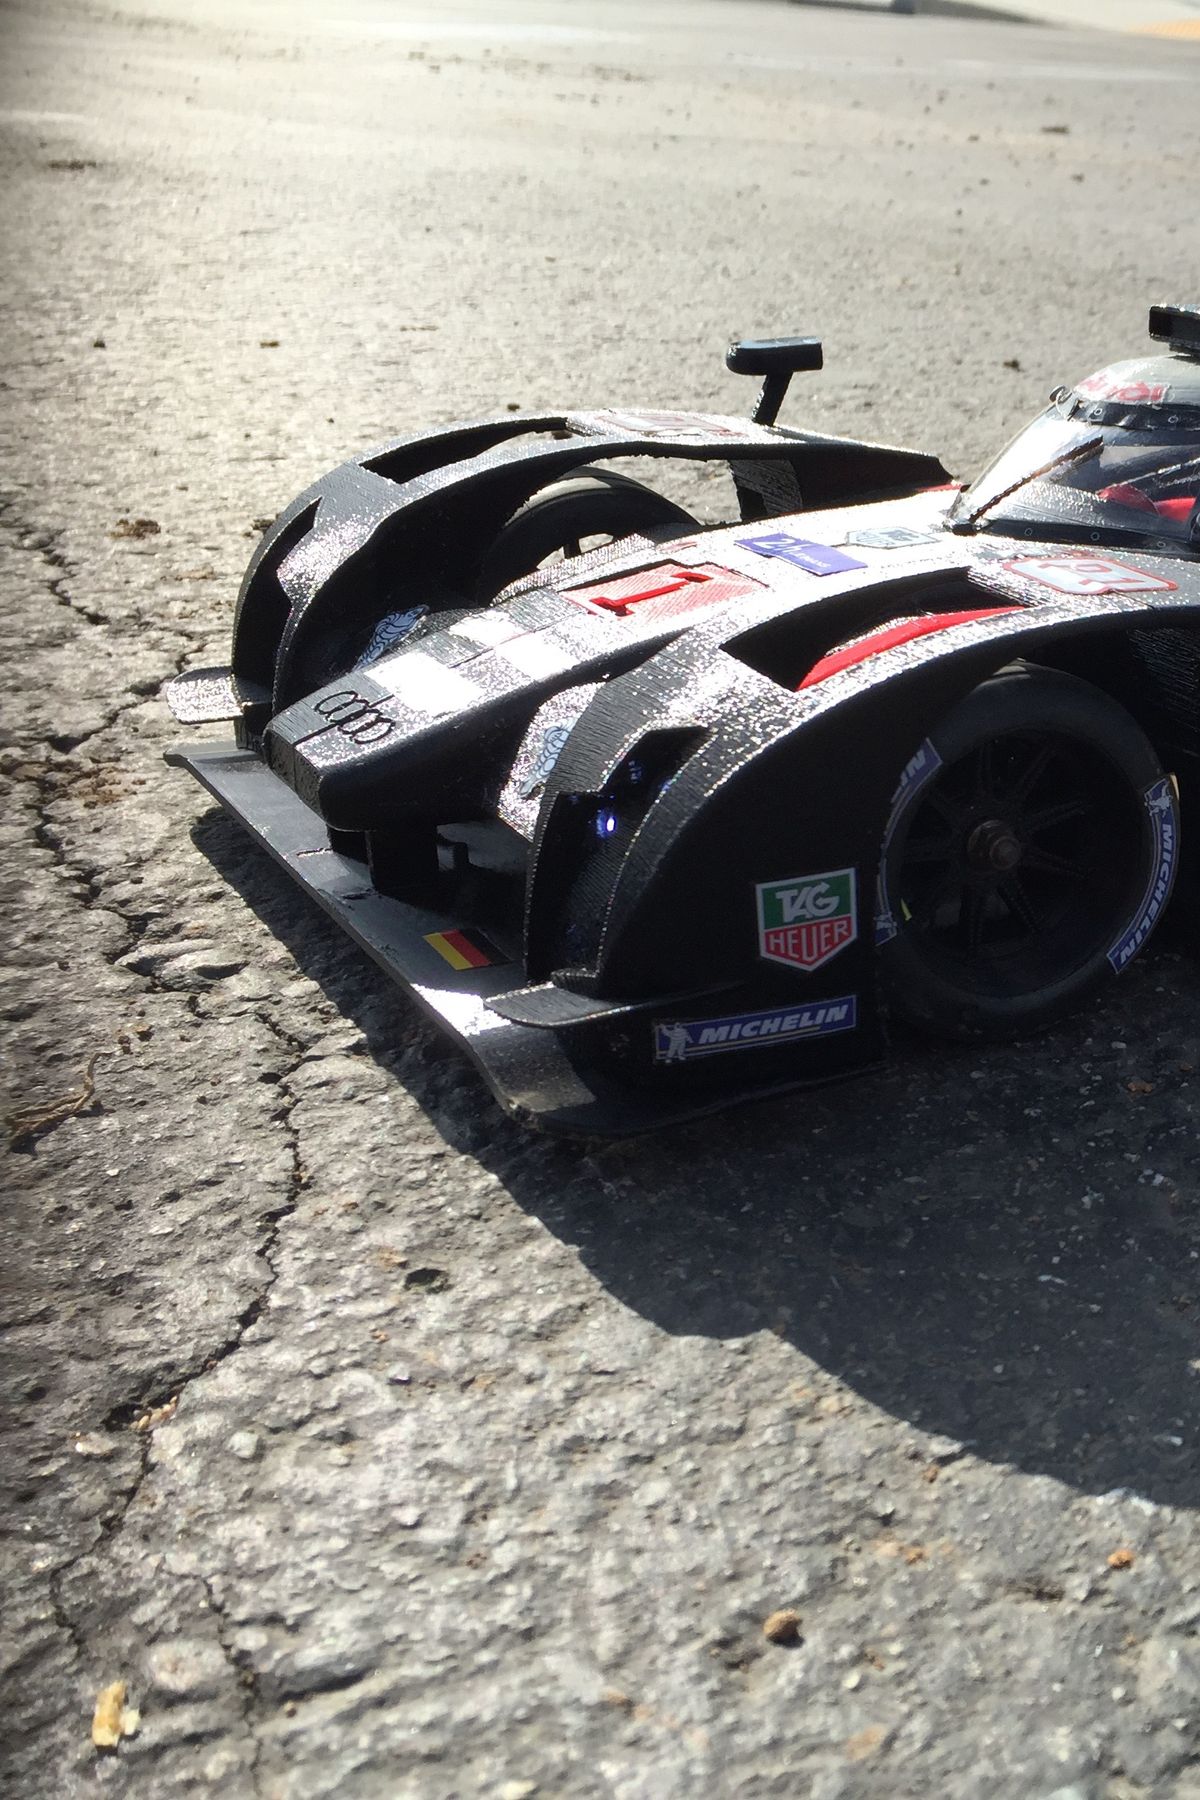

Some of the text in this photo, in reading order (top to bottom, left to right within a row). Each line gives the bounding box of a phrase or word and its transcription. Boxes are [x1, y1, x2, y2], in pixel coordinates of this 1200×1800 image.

[589, 571, 713, 617] 1
[775, 881, 840, 923] TAG
[1118, 823, 1173, 965] MICHELIN
[767, 919, 849, 960] HEUER
[700, 1003, 849, 1043] MICHELIN
